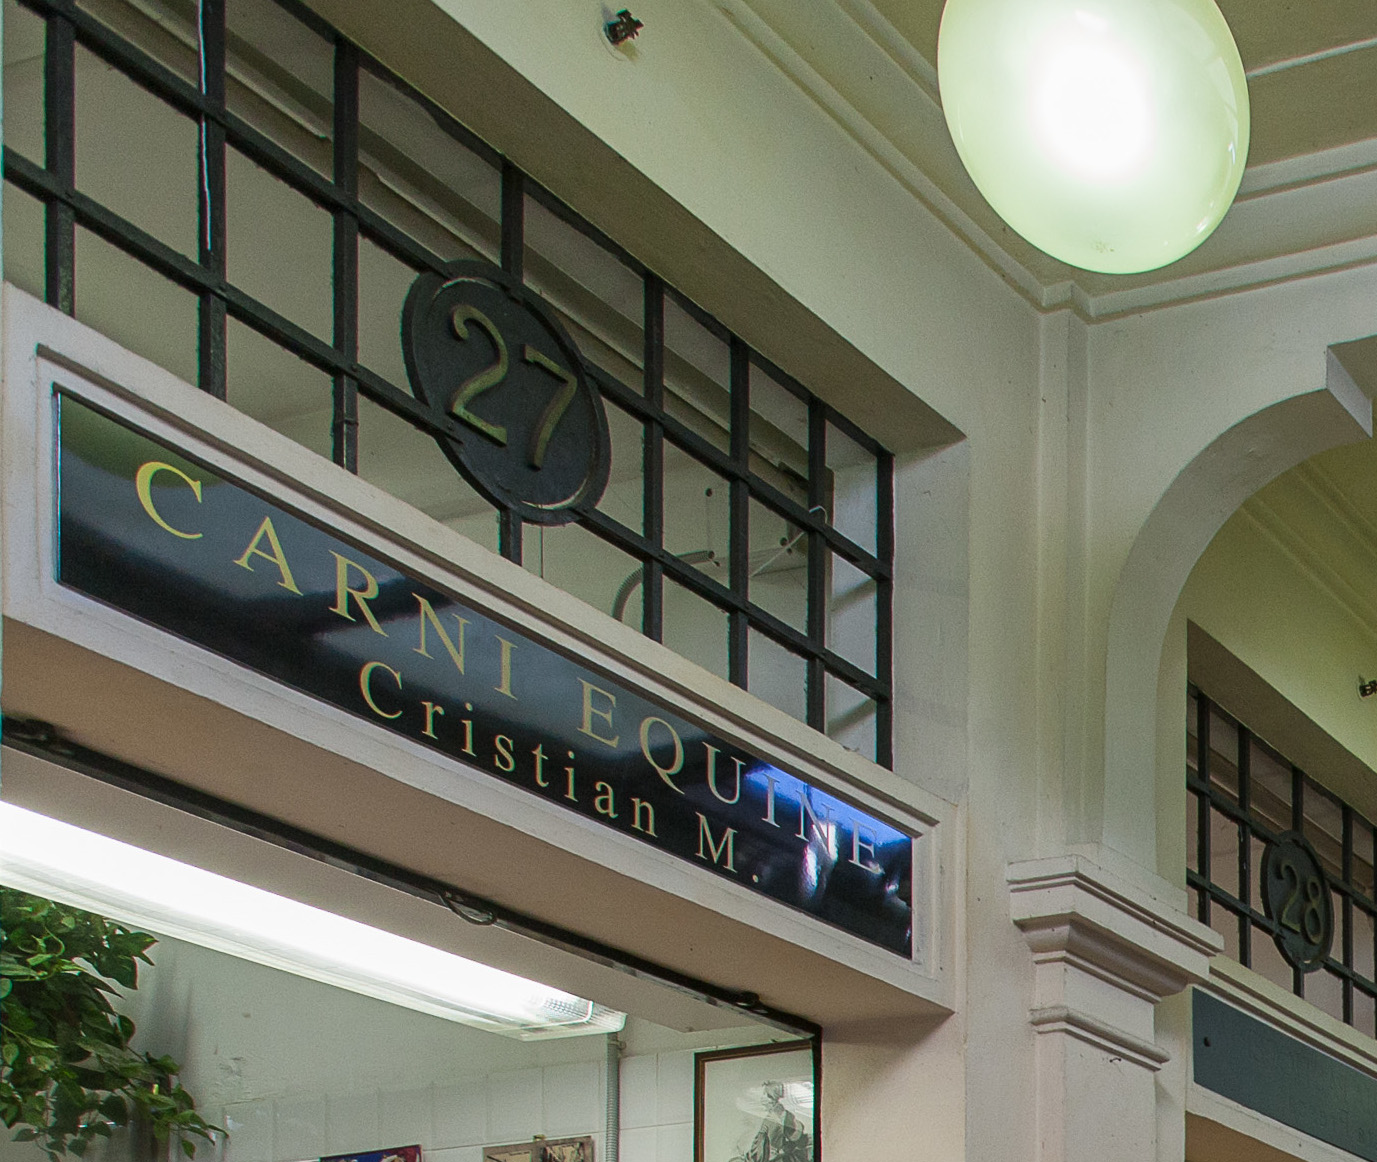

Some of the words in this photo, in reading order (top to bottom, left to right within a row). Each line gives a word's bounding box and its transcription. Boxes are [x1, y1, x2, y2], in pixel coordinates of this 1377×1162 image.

[449, 304, 579, 471] 27
[136, 460, 519, 700] CARNI
[577, 676, 883, 875] EQUINE
[358, 658, 658, 840] Cristian
[695, 812, 761, 885] M.
[1275, 859, 1324, 946] 28
